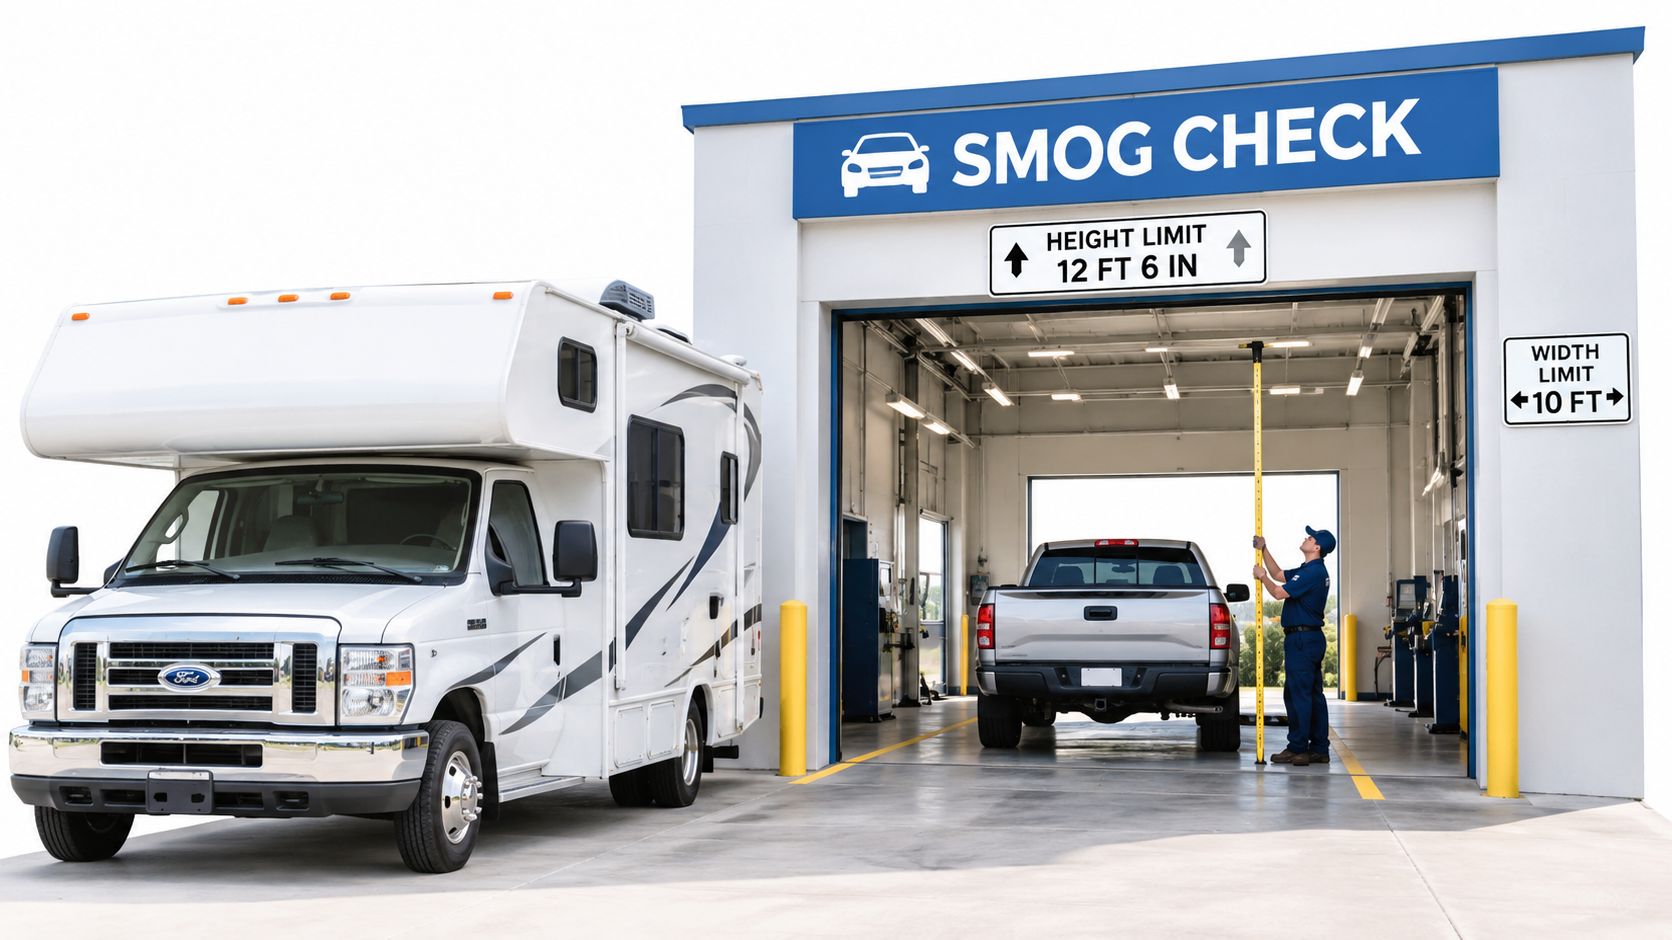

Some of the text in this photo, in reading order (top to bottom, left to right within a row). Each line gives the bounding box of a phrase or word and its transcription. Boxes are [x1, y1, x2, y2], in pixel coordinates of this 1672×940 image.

[952, 98, 1422, 187] SMOG CHECK
[1047, 223, 1207, 252] HEIGHT LIMIT
[1057, 253, 1197, 283] 12 FT 6 IN
[1531, 343, 1600, 362] WIDTH
[1539, 366, 1595, 383] LIMIT
[1532, 390, 1603, 414] 10 FT
